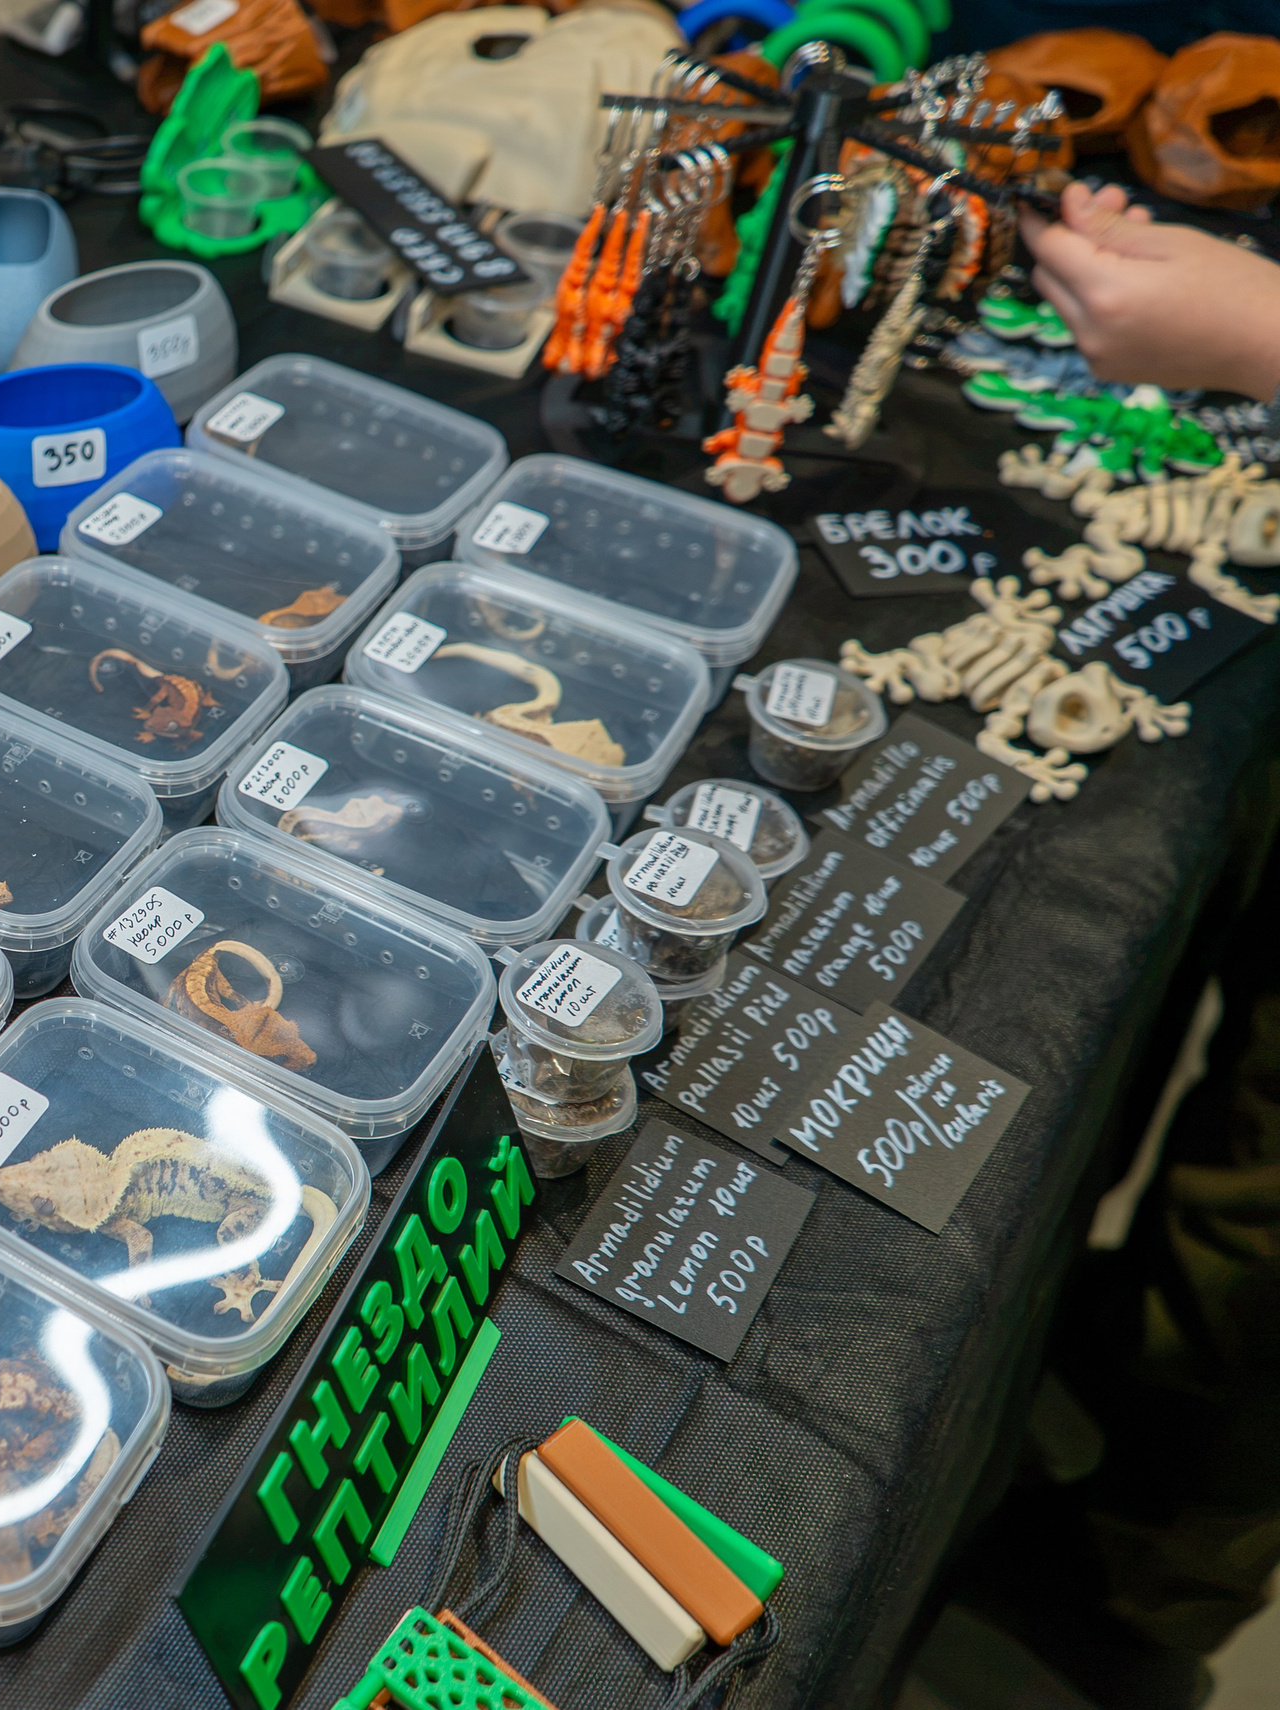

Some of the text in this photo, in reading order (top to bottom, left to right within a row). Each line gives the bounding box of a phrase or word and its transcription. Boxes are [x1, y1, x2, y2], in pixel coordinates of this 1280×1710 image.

[43, 441, 95, 472] 350
[816, 506, 983, 545] БРЕЛОК
[782, 890, 857, 977] nasatum
[815, 921, 878, 988] orange
[640, 964, 762, 1092] Armadilidium
[788, 1015, 915, 1152] МОКРИЦЫ
[571, 1134, 685, 1285] Armadilidium
[614, 1157, 718, 1309] granulatum
[656, 1230, 720, 1315] Lemon
[706, 1234, 770, 1315] 500р
[257, 1156, 468, 1545] ГНЕЗДО
[240, 1134, 535, 1710] РЕПТИЛИЙ
